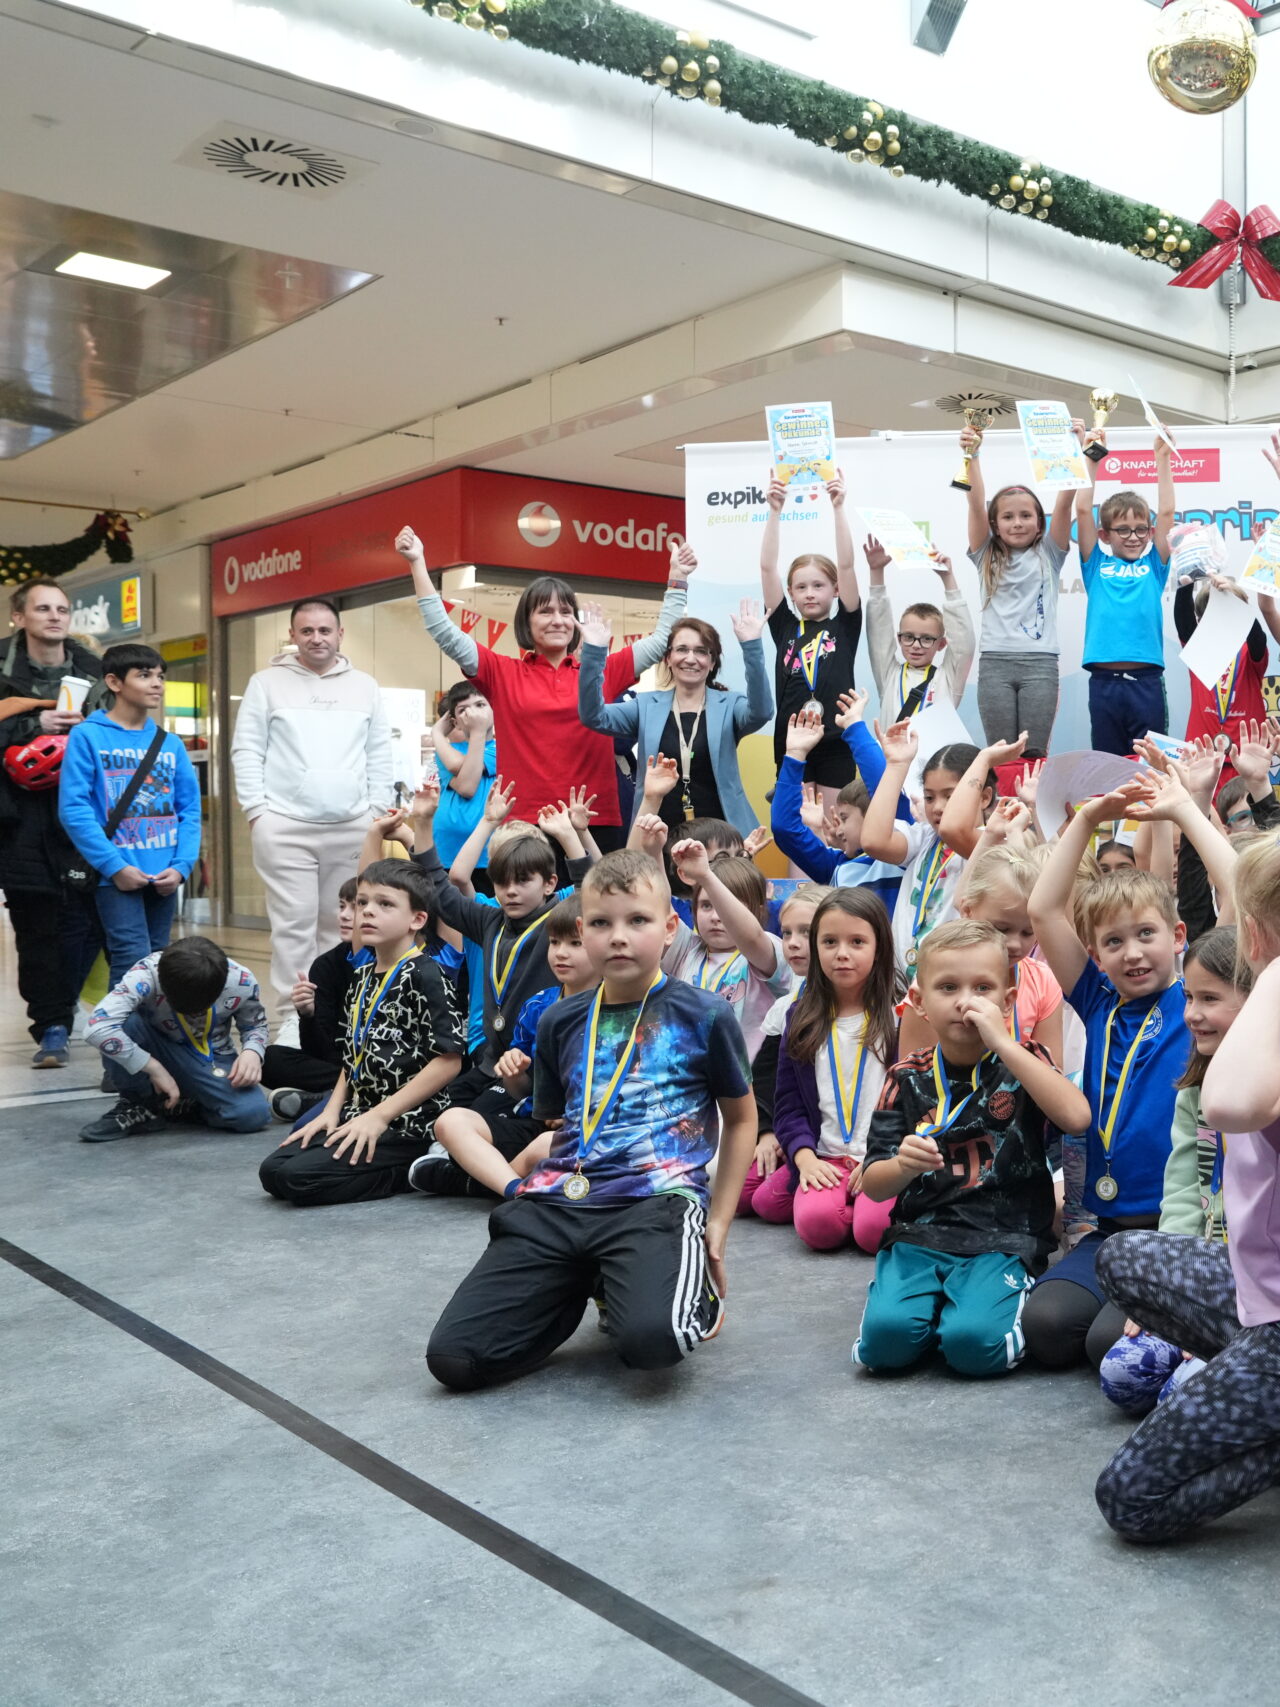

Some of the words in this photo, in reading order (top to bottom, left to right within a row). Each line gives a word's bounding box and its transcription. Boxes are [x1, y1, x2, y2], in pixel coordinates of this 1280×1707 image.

[1123, 459, 1206, 470] KNAPCHAFT
[707, 512, 749, 526] gesund
[752, 511, 818, 523] aufachsen
[241, 548, 302, 583] vodafone
